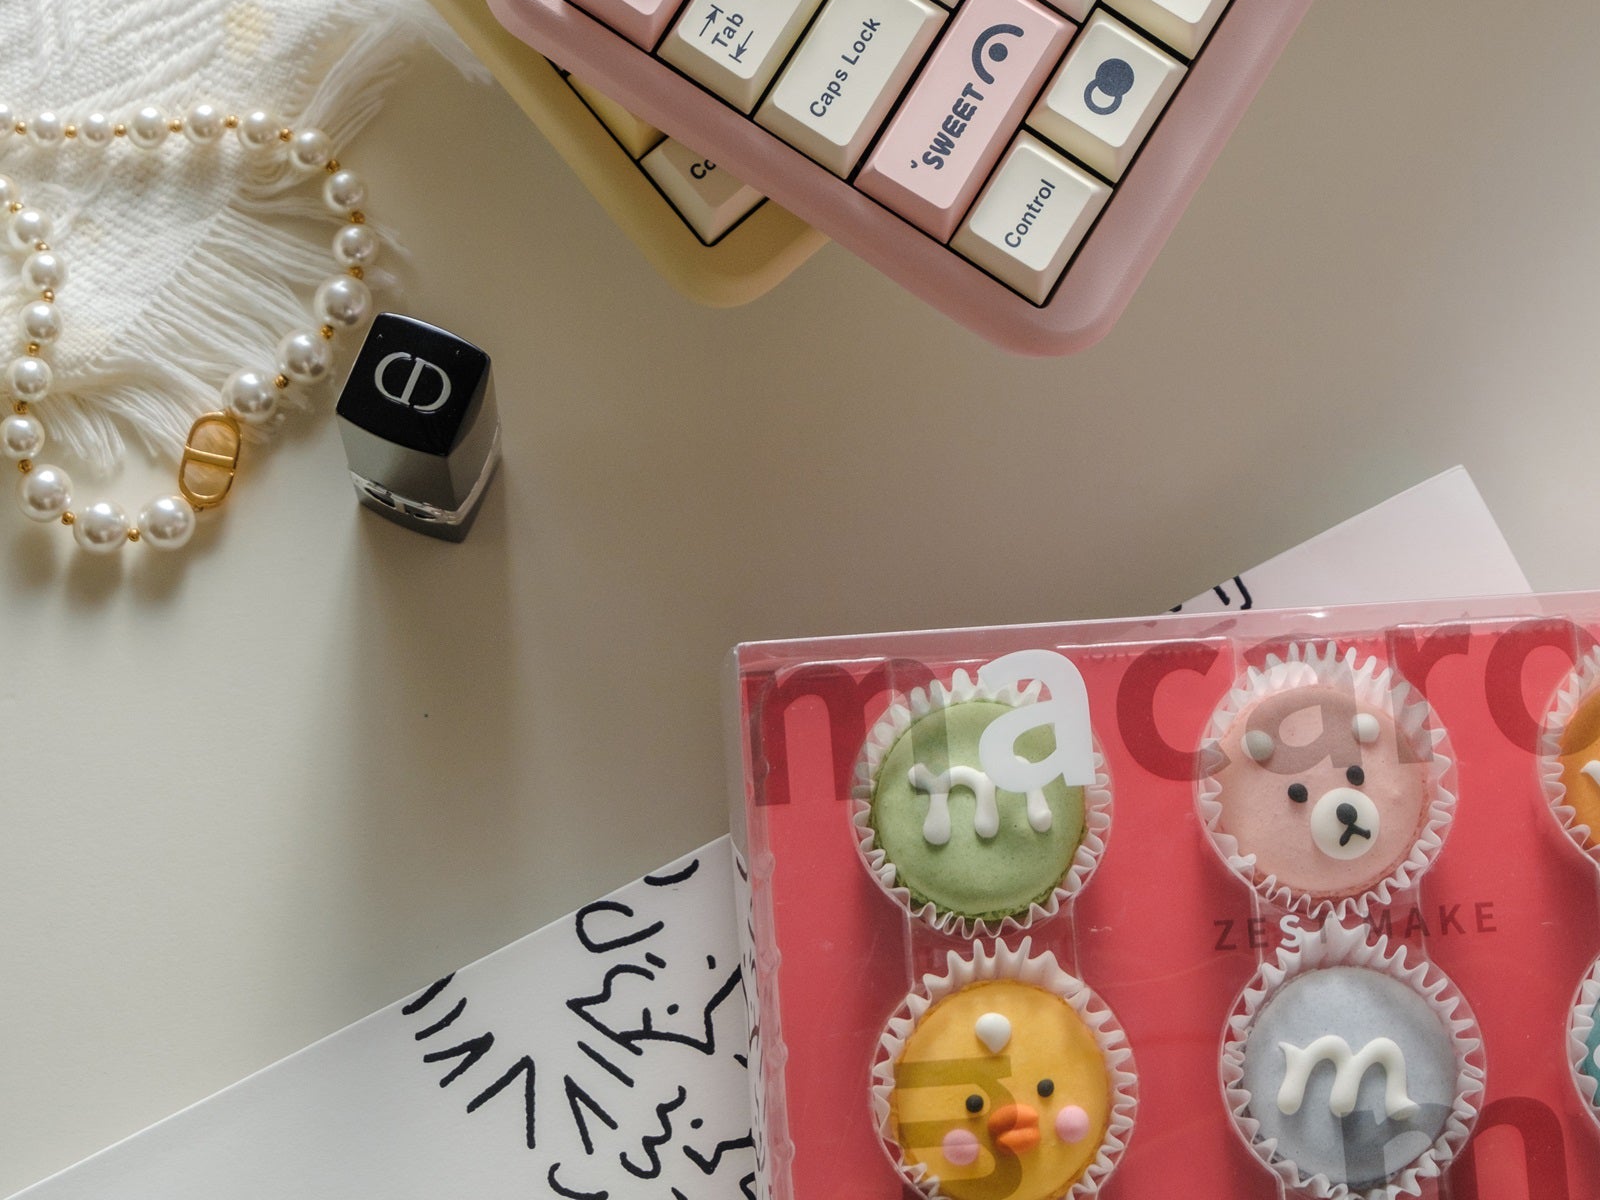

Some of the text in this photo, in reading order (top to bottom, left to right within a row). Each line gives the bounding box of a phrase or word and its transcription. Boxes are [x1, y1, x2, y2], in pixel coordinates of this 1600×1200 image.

[713, 11, 745, 49] Tab
[810, 19, 880, 117] Caps Lock
[922, 82, 985, 170] SWEET
[1005, 179, 1055, 247] Control
[745, 618, 1600, 806] macaro
[1213, 901, 1498, 951] ZEST MAKE
[1277, 1034, 1420, 1121] m
